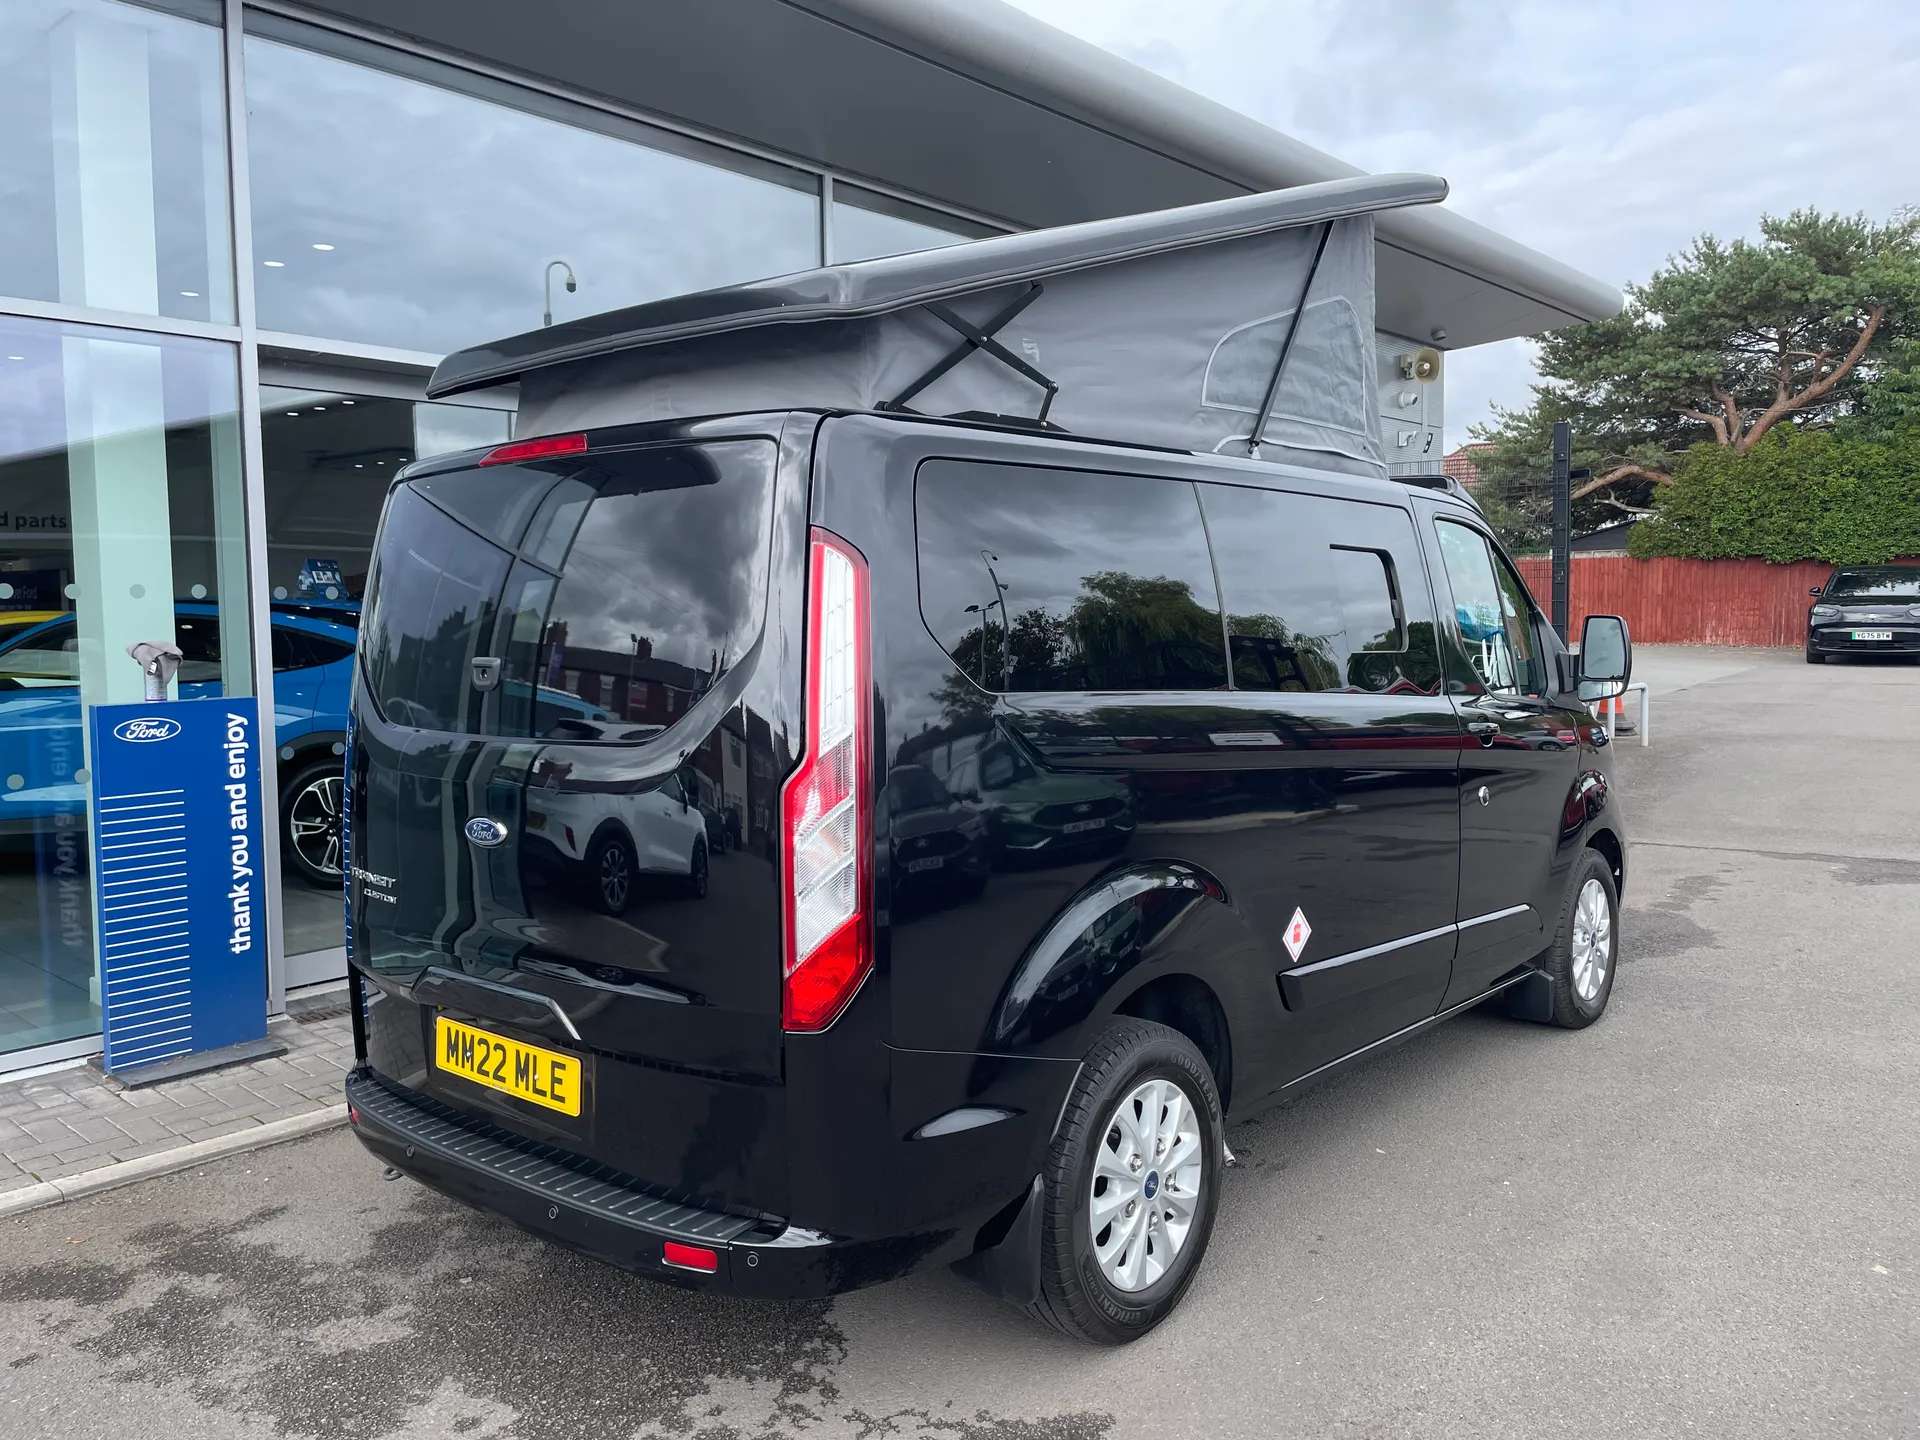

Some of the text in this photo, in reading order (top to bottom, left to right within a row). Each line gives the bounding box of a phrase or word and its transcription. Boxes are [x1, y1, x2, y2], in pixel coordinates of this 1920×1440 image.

[15, 514, 67, 531] parts
[125, 720, 170, 739] Ford
[223, 712, 253, 954] thank you and enjoy
[350, 866, 397, 888] TRANSIT
[364, 888, 397, 904] CUSTOM
[446, 1026, 567, 1104] MM22 MLE
